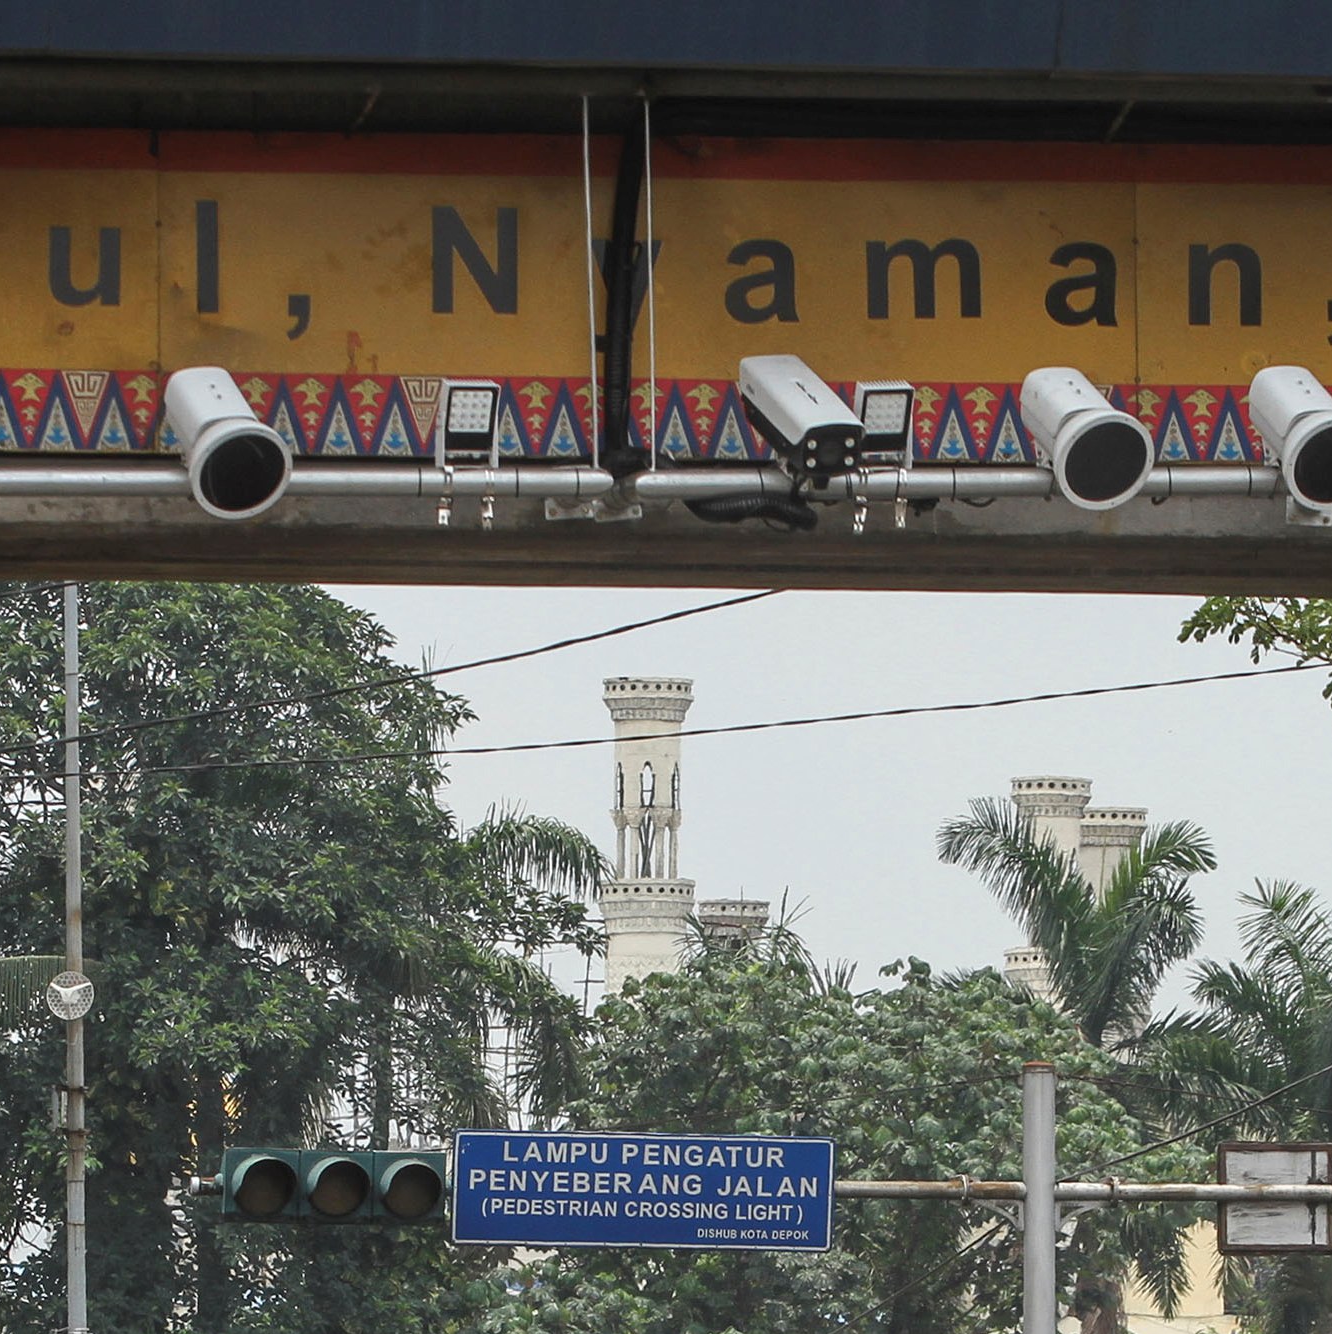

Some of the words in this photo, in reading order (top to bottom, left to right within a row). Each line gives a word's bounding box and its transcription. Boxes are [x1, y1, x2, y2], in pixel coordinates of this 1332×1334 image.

[503, 1140, 610, 1164] LAMPU
[621, 1143, 784, 1168] PENGATUR
[468, 1169, 702, 1195] PENYEBERANG
[717, 1175, 818, 1198] JALAN
[481, 1197, 617, 1218] (PEDESTRIAN
[624, 1202, 729, 1221] CROSSING
[734, 1204, 803, 1225] LIGHT)
[697, 1228, 738, 1240] DISHUB
[740, 1229, 769, 1240] KOTA
[772, 1229, 809, 1241] DEPOK
